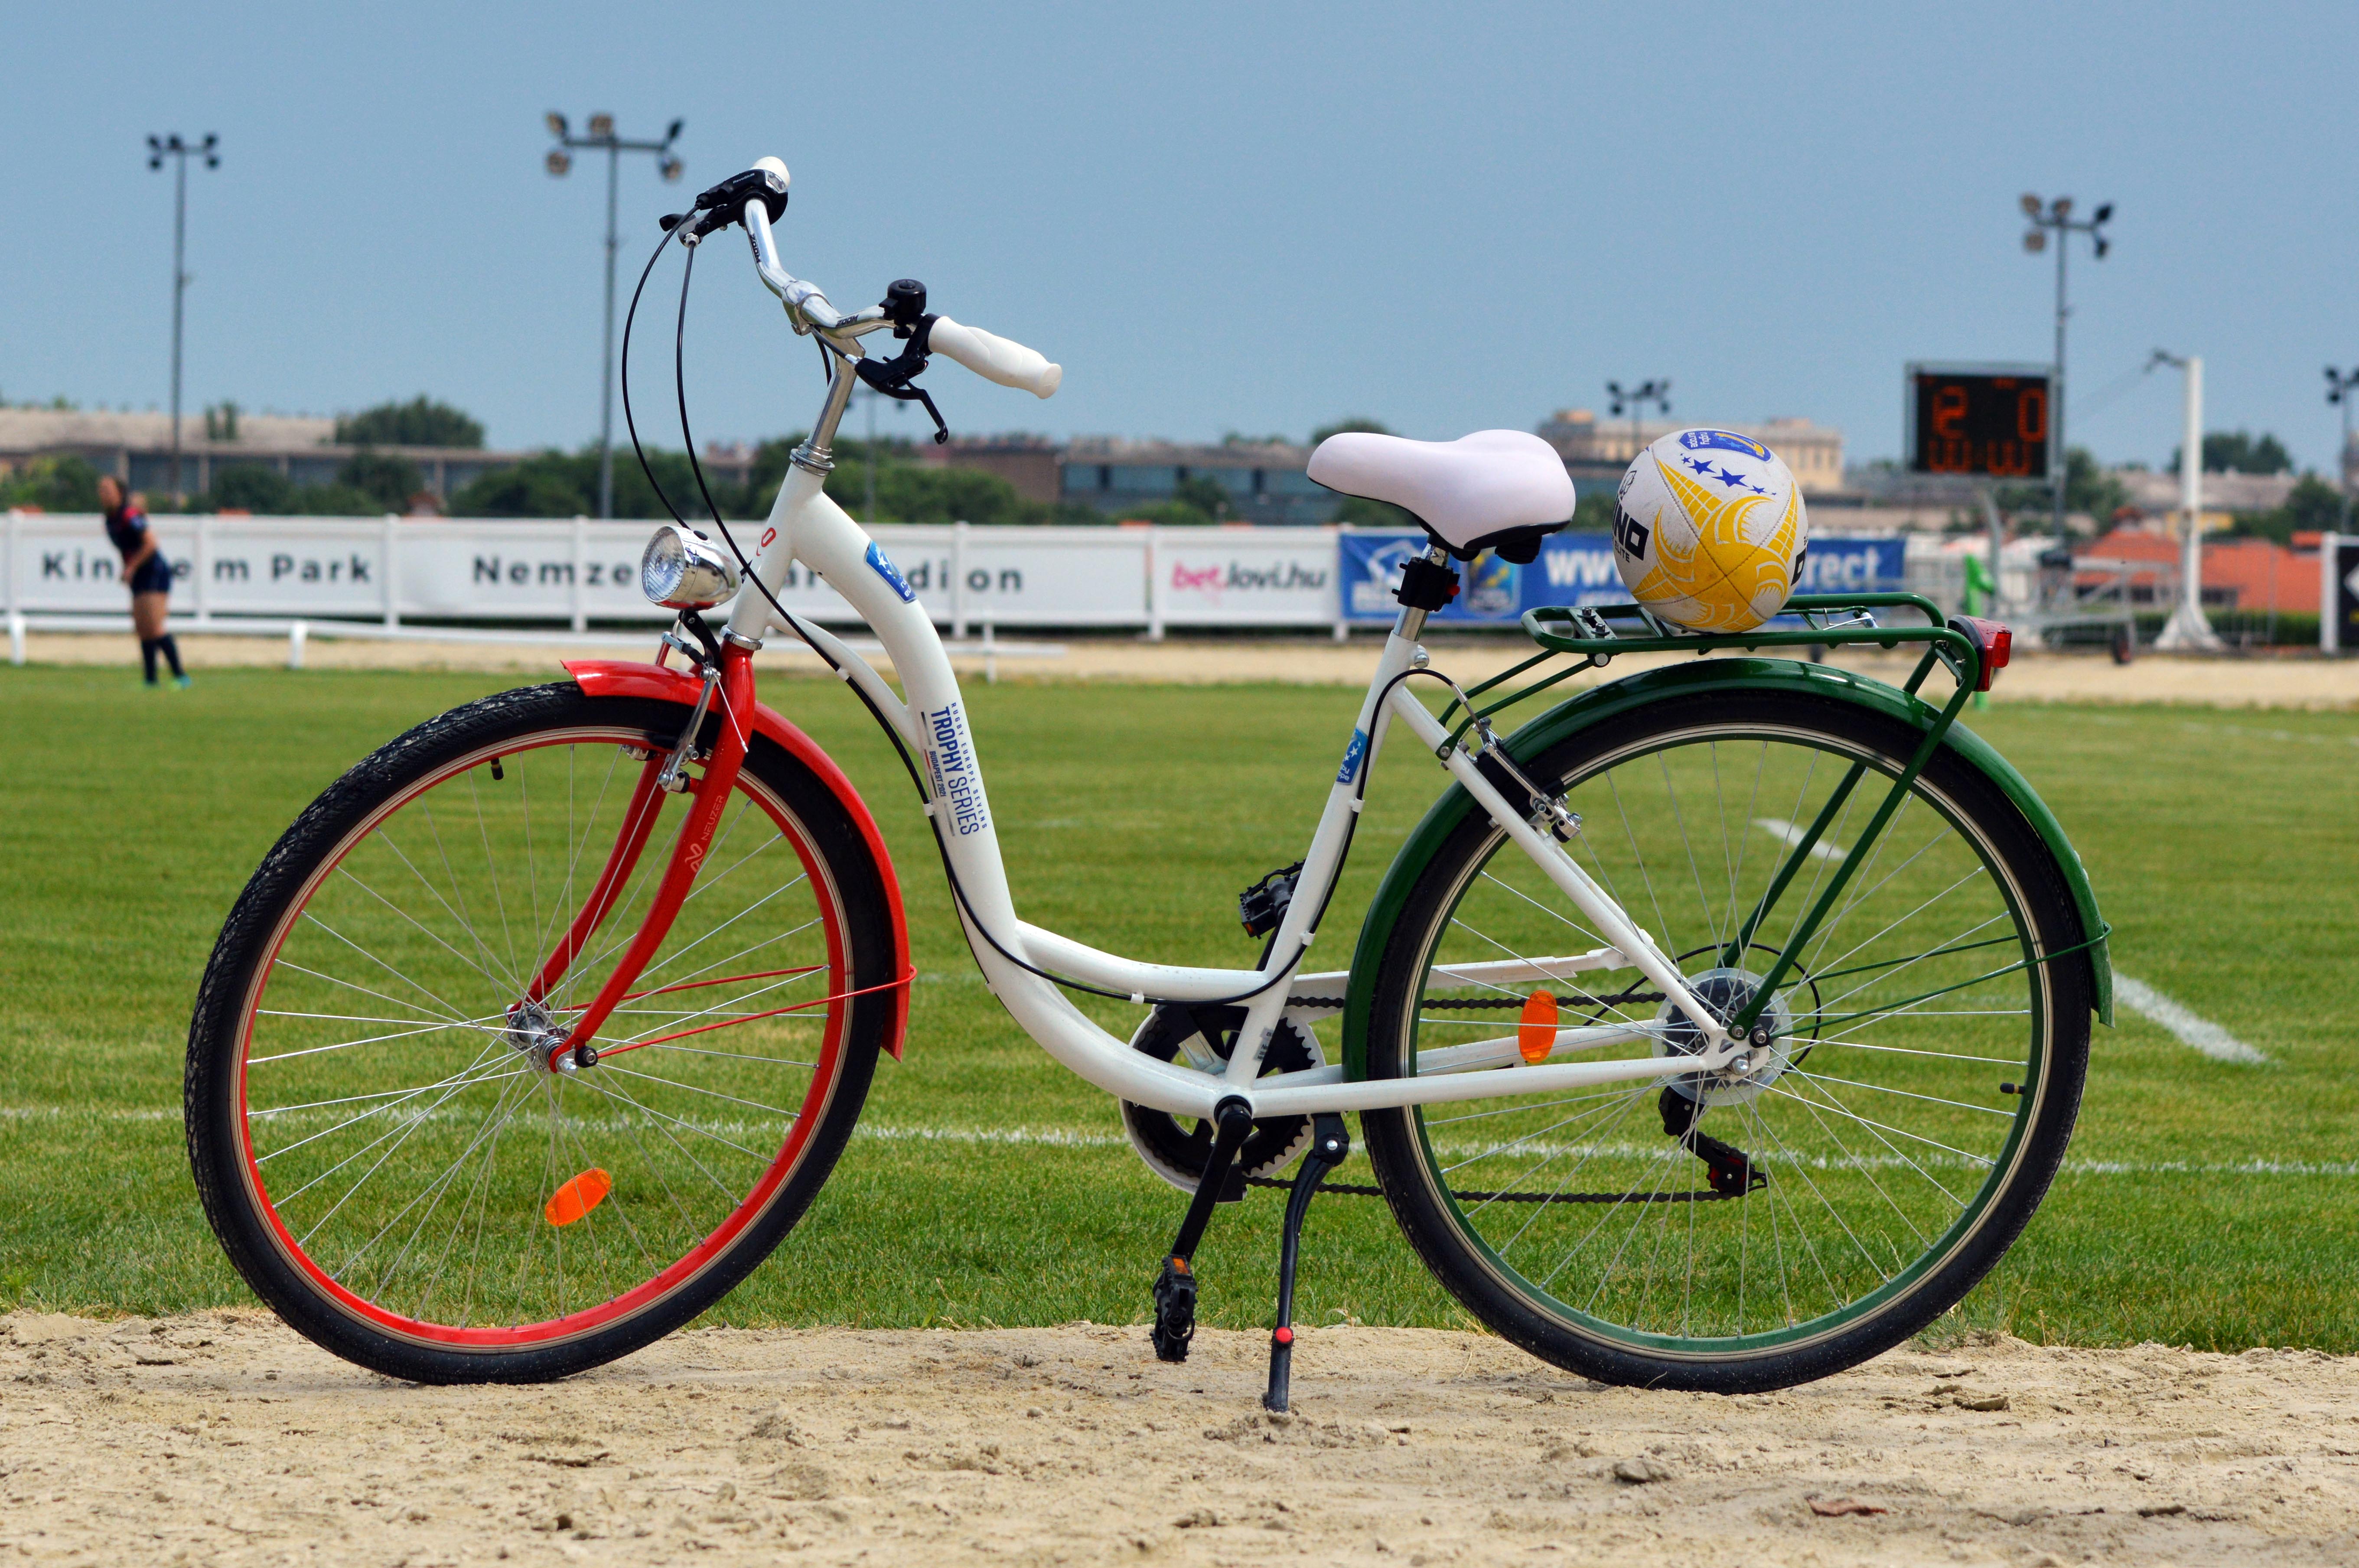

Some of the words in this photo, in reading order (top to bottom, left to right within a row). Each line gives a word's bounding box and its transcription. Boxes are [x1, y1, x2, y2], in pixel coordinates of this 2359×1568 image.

[749, 233, 761, 264] ZOOM
[836, 314, 859, 327] ZOOM
[42, 550, 250, 581] Kinem
[272, 553, 371, 582] Park
[1615, 540, 1630, 563] ELITE
[474, 556, 633, 585] Nemze
[909, 559, 1023, 591] dion
[929, 751, 943, 783] BUDAPEST
[937, 783, 947, 797] 2021
[931, 706, 964, 773] TROPHY
[948, 776, 979, 836] SERIES
[951, 702, 964, 736] RUGBY
[961, 742, 975, 783] EUROPE
[973, 789, 987, 829] SEVENS
[701, 795, 724, 841] NEUZER
